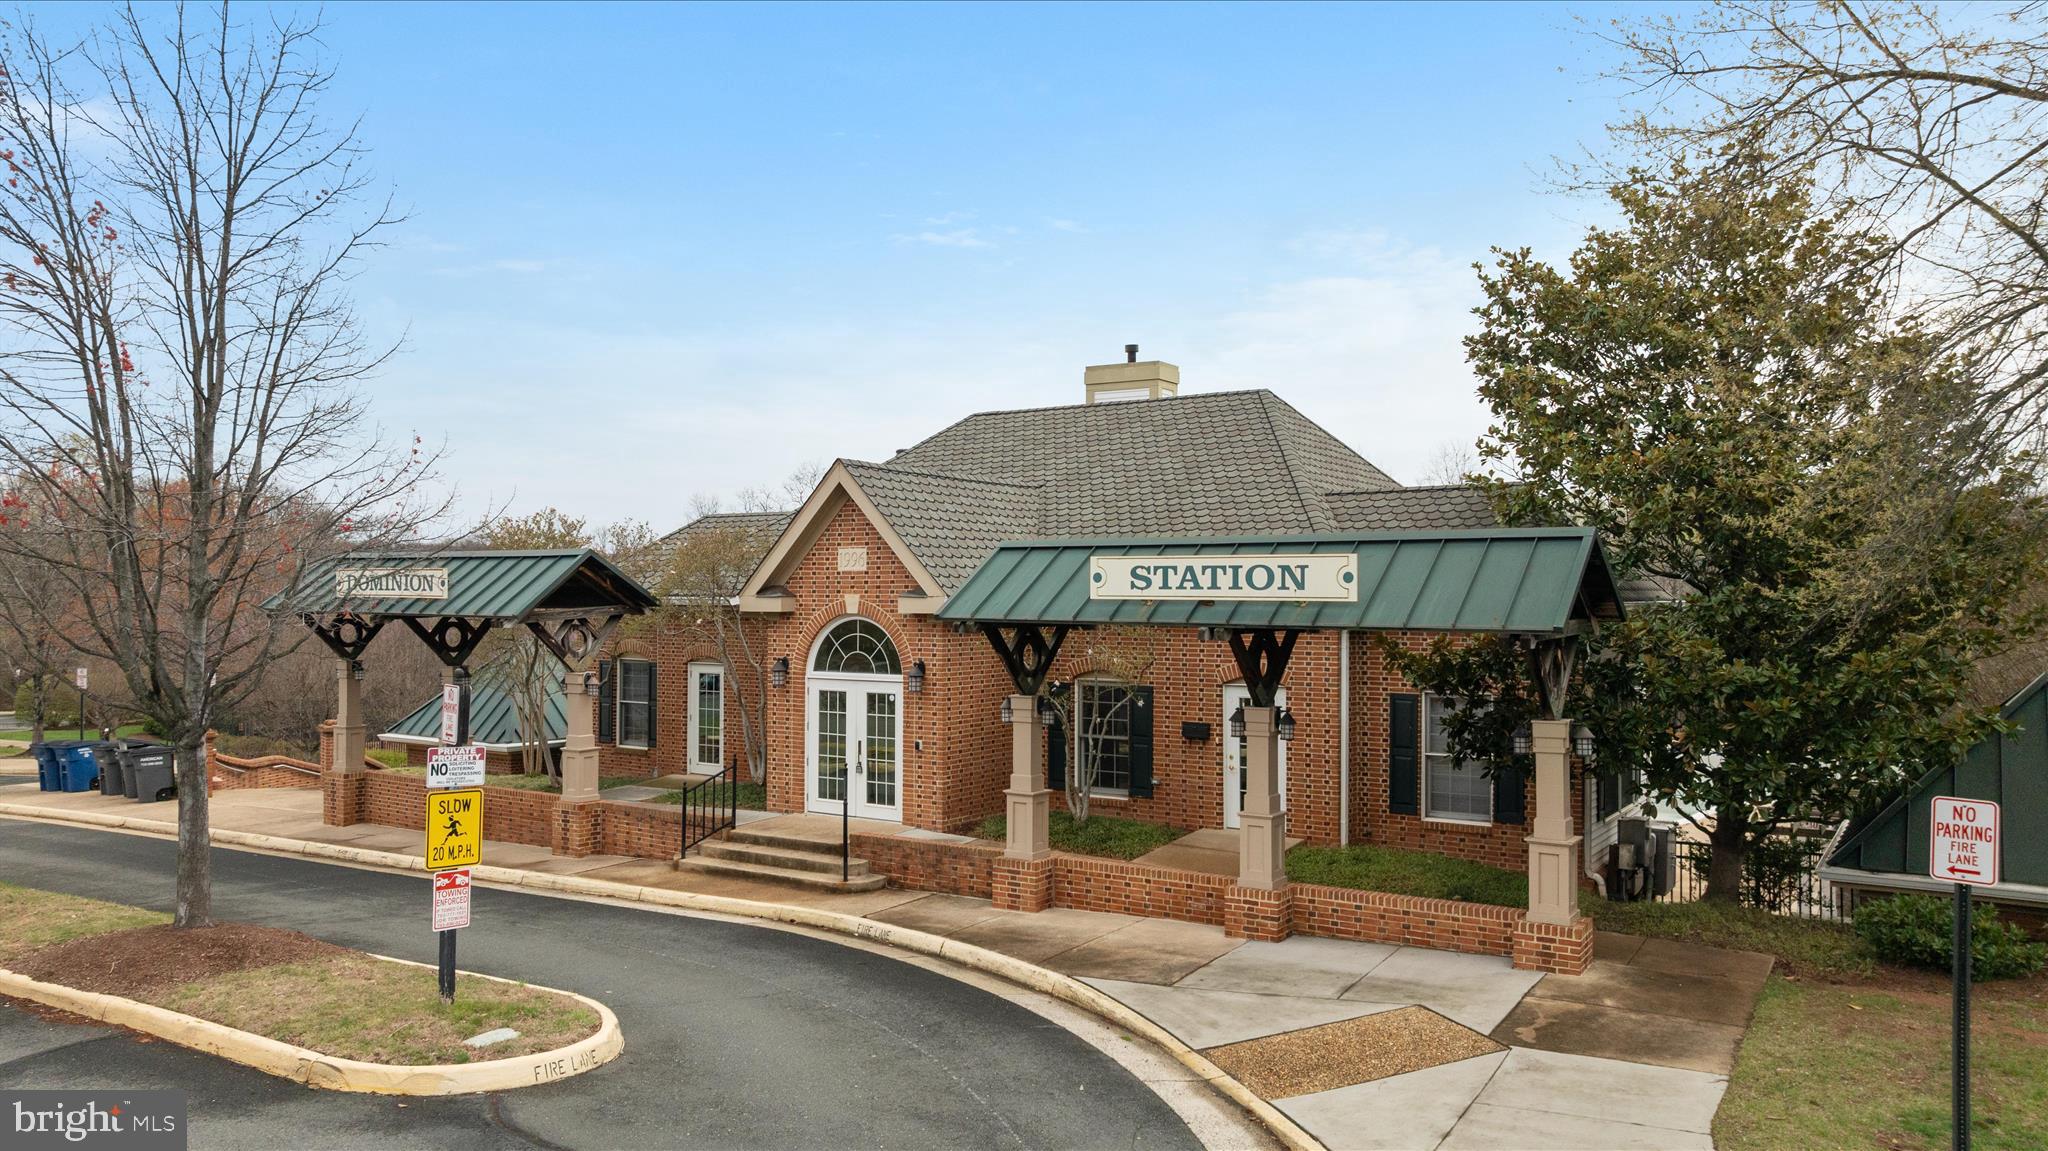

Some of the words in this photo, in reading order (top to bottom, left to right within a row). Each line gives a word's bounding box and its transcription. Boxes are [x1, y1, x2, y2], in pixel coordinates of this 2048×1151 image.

[345, 574, 435, 592] DOMINION
[1129, 564, 1309, 591] STATION
[432, 753, 481, 762] PROPERTY
[438, 747, 476, 755] PRIVATE
[430, 763, 448, 776] NO
[438, 797, 472, 814] SLOW
[1952, 805, 1976, 822] NO
[1936, 822, 1993, 843] PARKING
[433, 846, 444, 861] 20
[447, 843, 474, 860] M.P.H.
[1950, 841, 1977, 854] FIRE
[1948, 853, 1979, 867] LANE
[437, 887, 468, 898] TOWING
[436, 895, 467, 907] ENFORCED
[534, 1059, 566, 1082] FIRE
[570, 1049, 598, 1072] LANE
